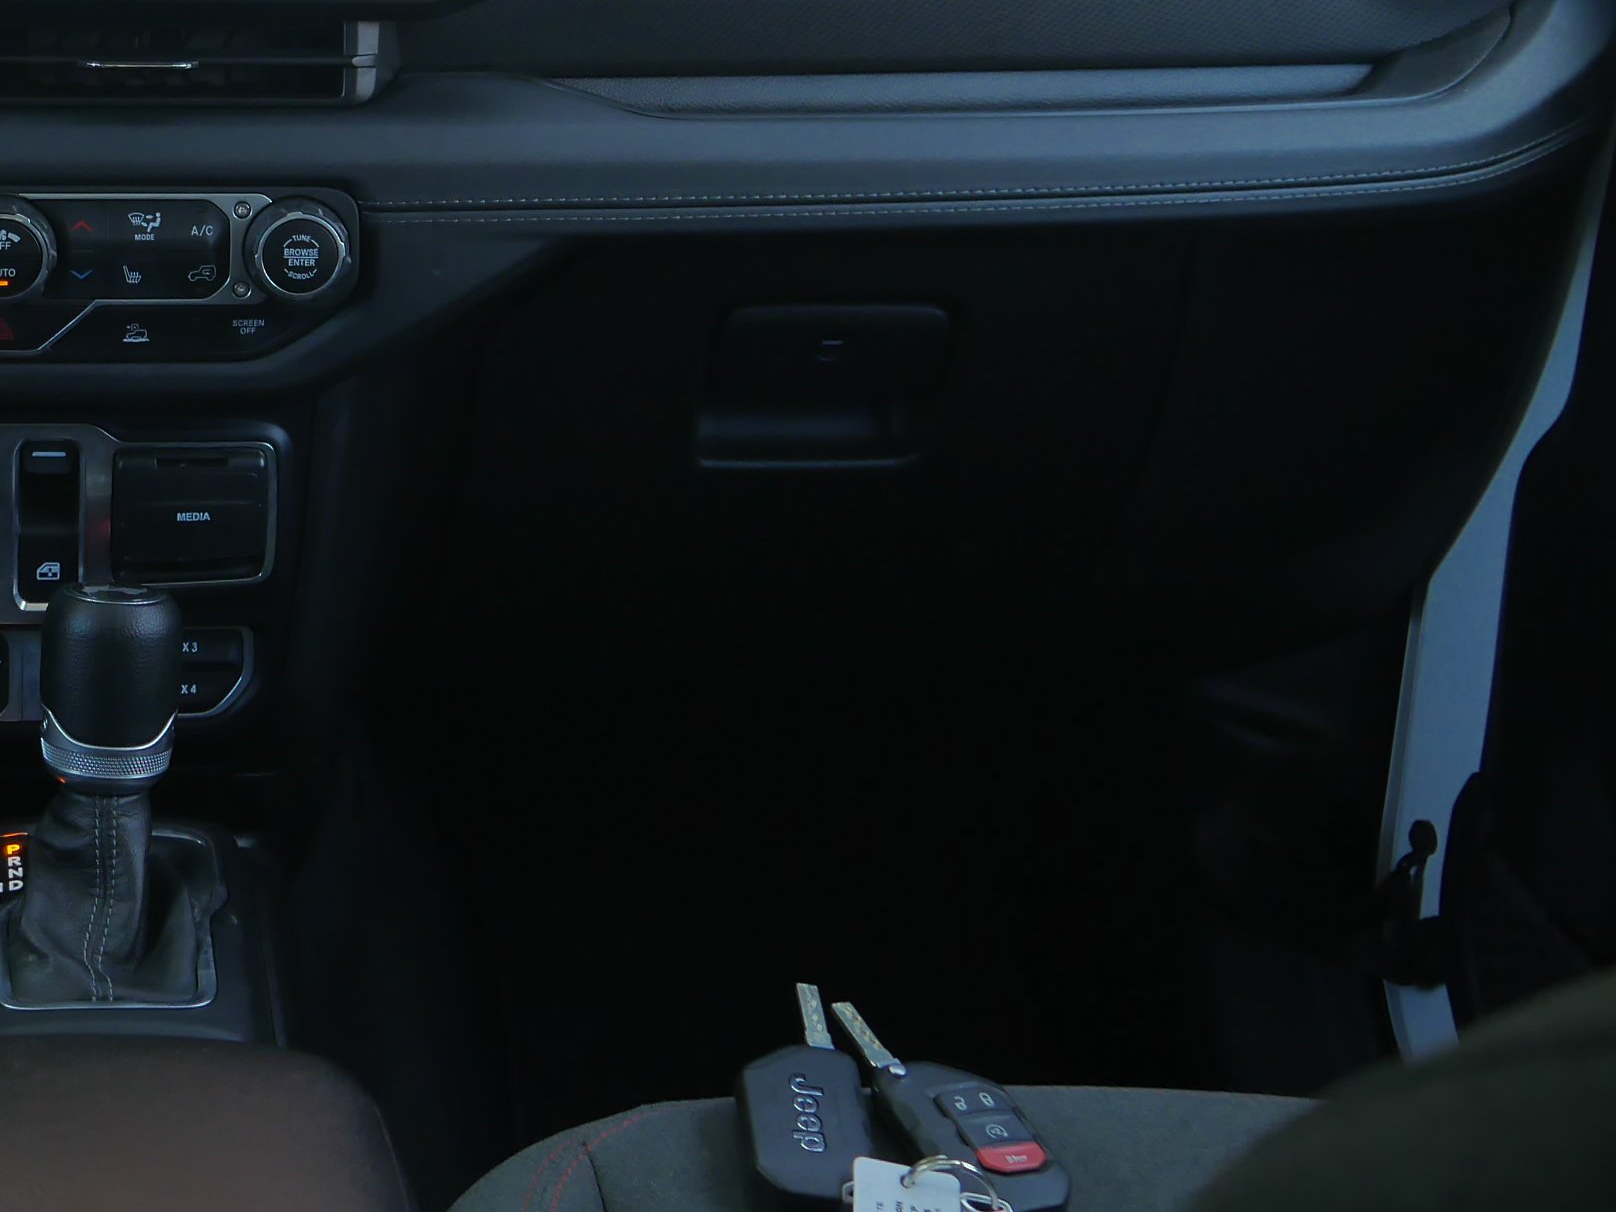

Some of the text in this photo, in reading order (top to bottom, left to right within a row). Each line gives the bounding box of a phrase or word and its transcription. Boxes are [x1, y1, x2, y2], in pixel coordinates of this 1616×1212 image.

[191, 225, 213, 237] A/C
[134, 233, 155, 241] MODE
[292, 235, 312, 243] TUNE
[284, 248, 319, 256] BROWSE
[288, 258, 316, 267] ENTER
[287, 270, 315, 281] SCROLL
[232, 319, 265, 327] SCREEN
[177, 512, 211, 522] MEDIA
[191, 642, 198, 652] 3
[190, 684, 197, 694] 4
[7, 844, 20, 855] P
[7, 856, 22, 867] R
[8, 867, 23, 879] N
[9, 879, 24, 891] D
[788, 1073, 826, 1154] Jeep
